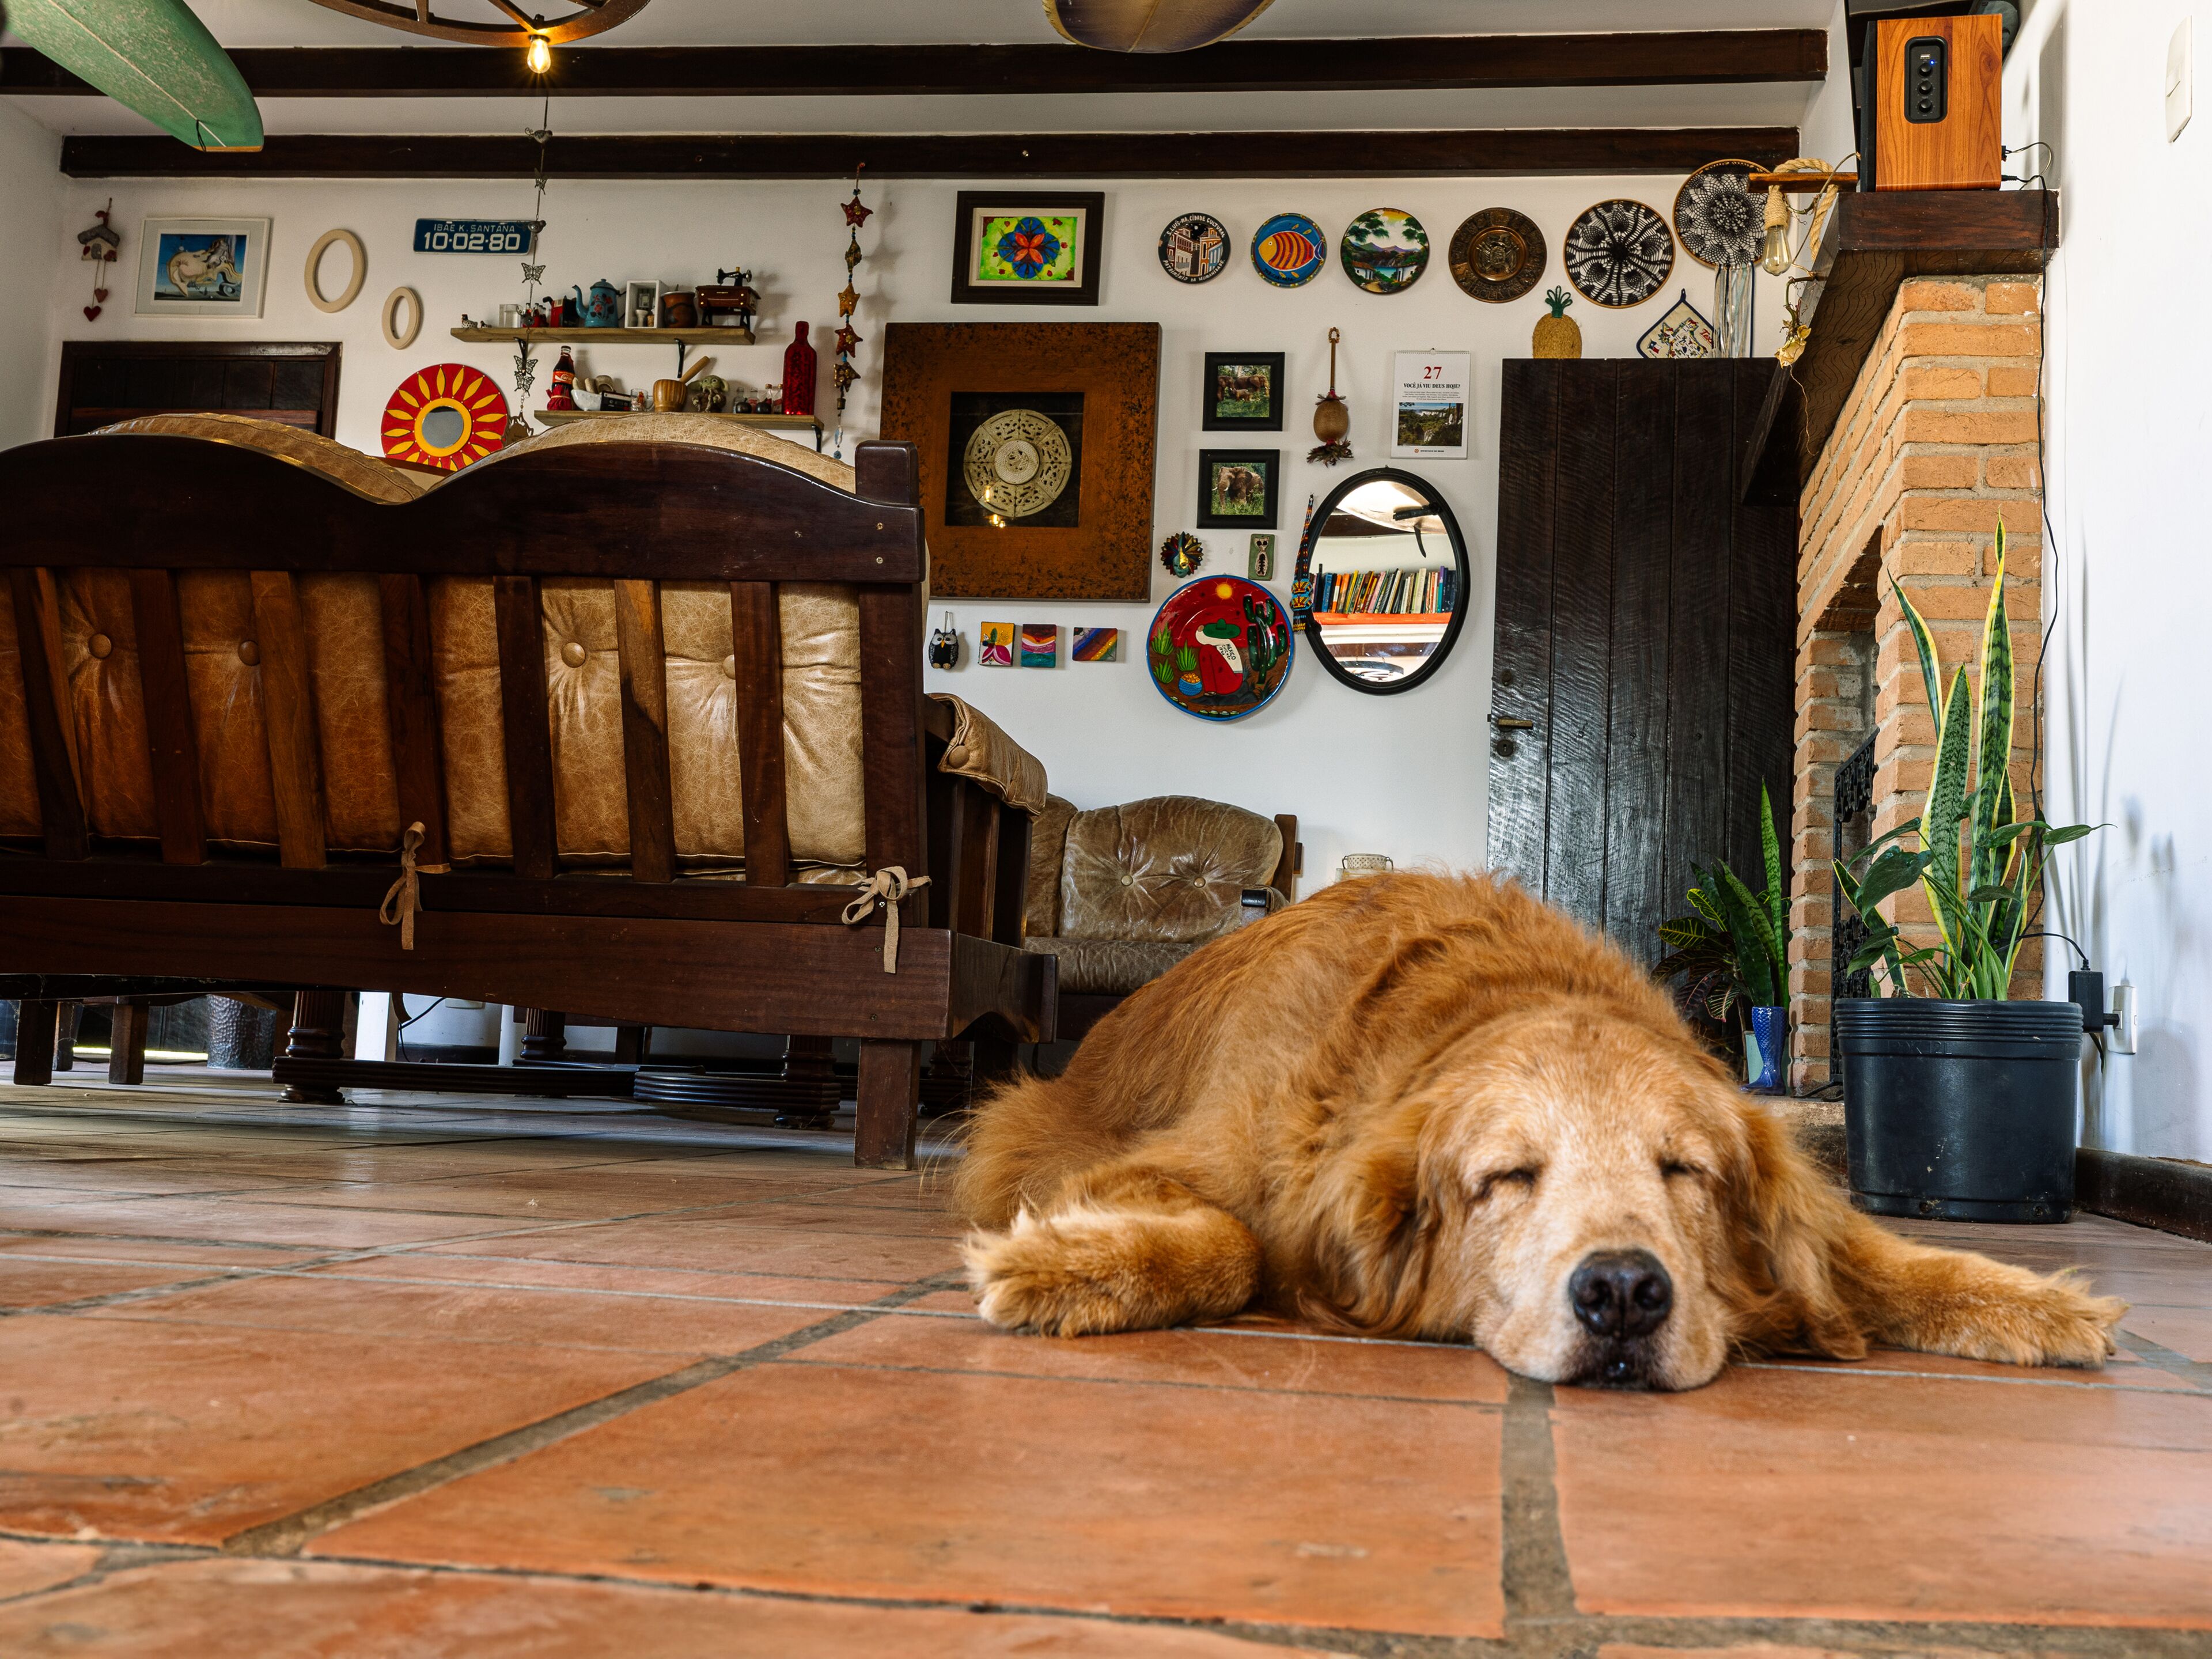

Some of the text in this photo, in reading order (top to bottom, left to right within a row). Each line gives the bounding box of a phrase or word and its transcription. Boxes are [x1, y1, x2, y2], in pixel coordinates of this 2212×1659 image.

[1206, 218, 1225, 238] CULTURAL
[1423, 366, 1442, 379] 27
[1226, 643, 1236, 660] MEXICO
